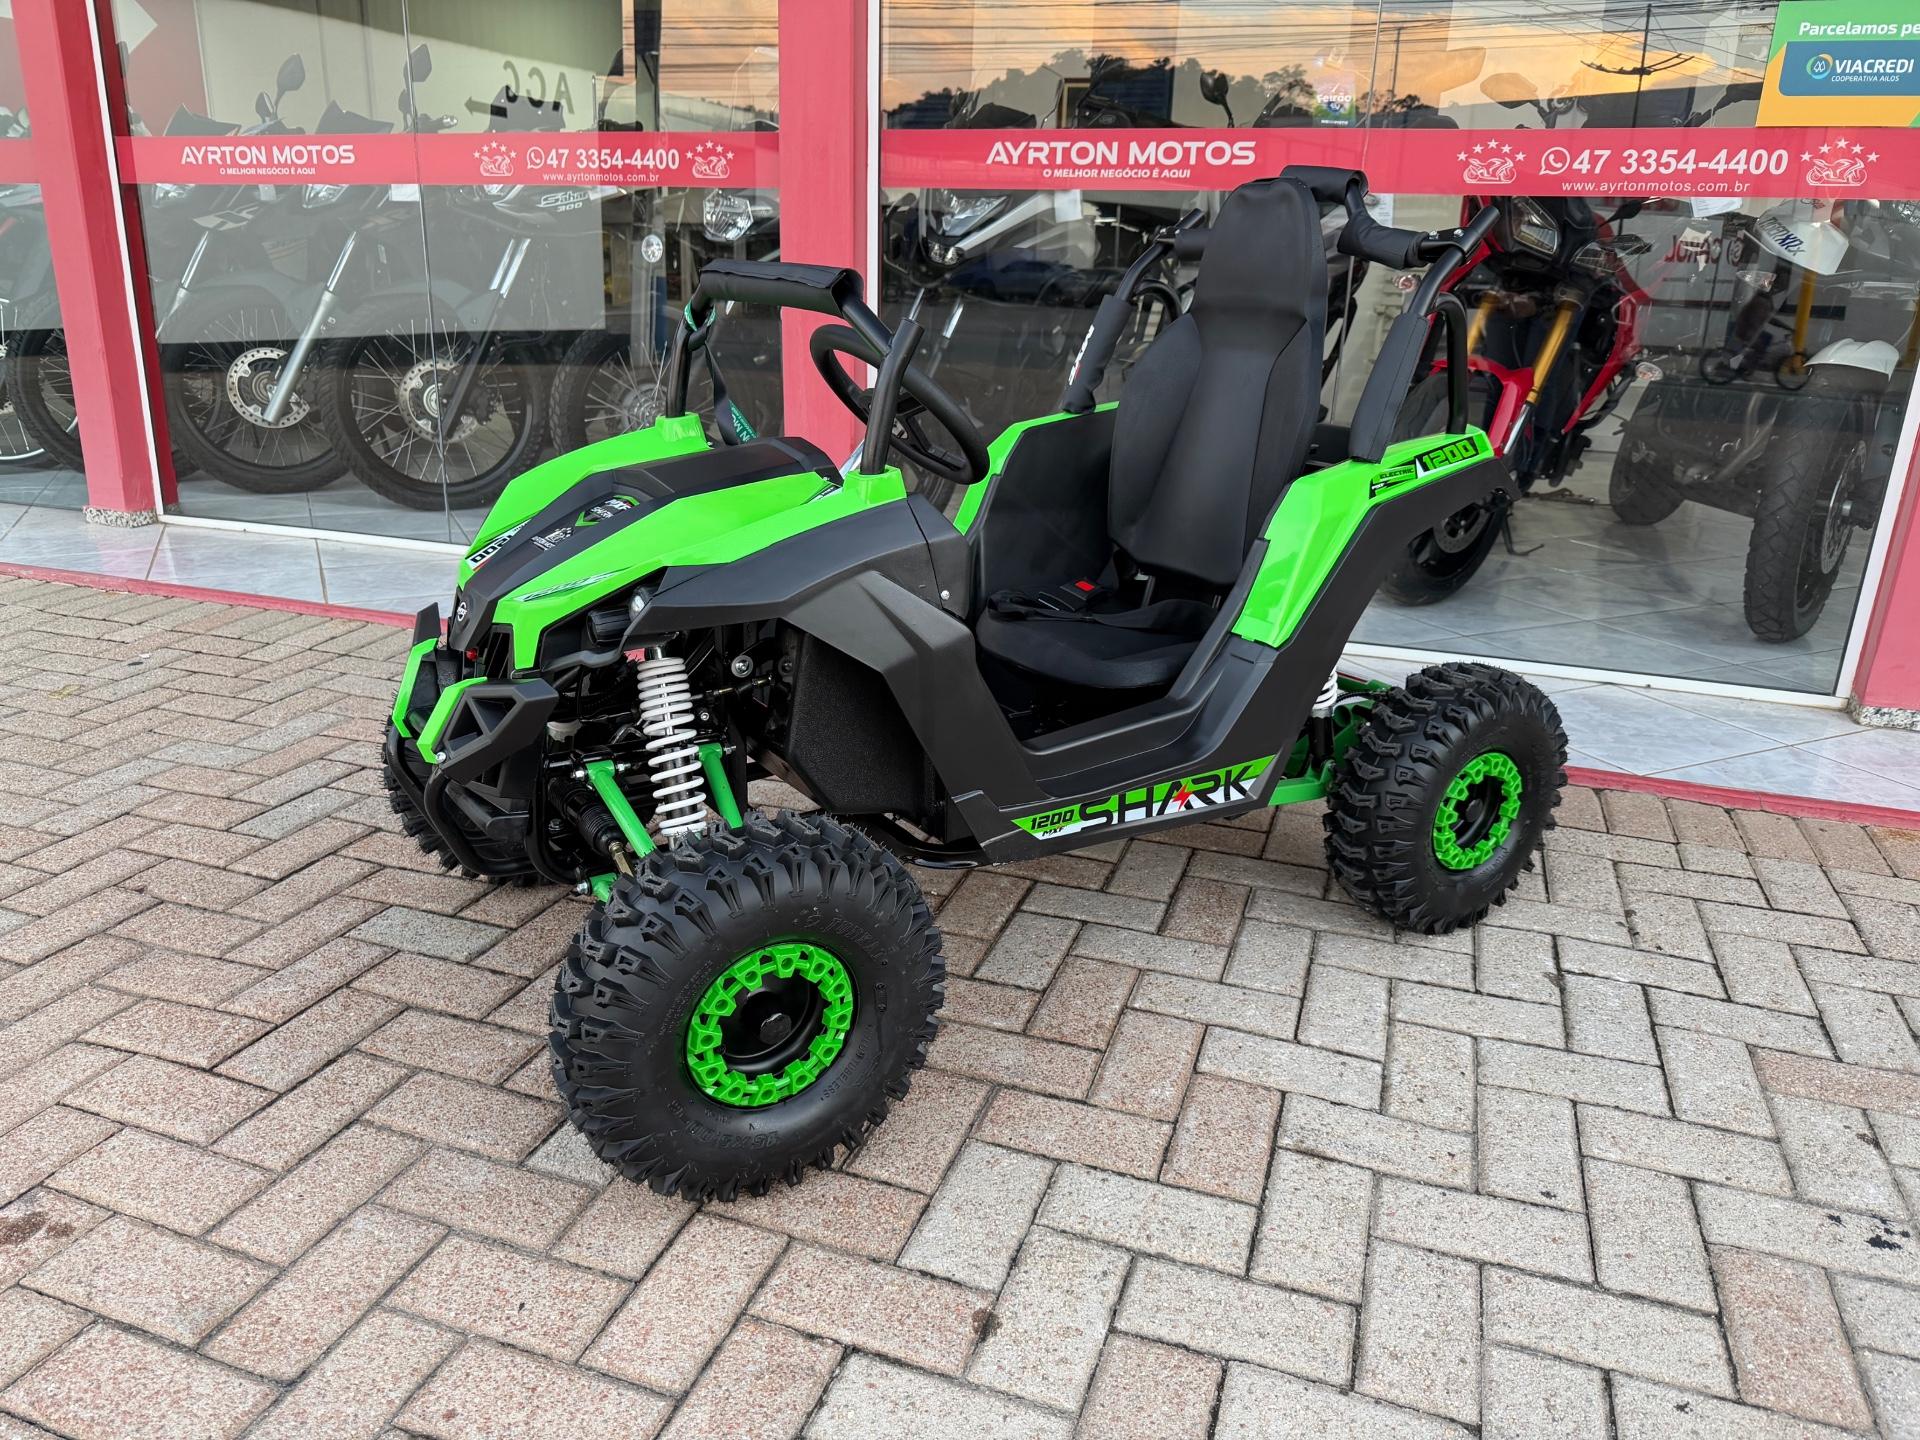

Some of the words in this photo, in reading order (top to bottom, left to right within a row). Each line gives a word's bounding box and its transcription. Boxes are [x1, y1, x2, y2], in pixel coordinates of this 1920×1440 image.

[1799, 21, 1897, 36] Parcelamos
[1835, 58, 1915, 74] VIACREDI
[181, 145, 267, 165] AYRTON
[273, 144, 356, 165] MOTOS
[546, 149, 570, 169] 47
[576, 148, 680, 170] 3354-4400
[985, 141, 1118, 165] AYRTON
[1128, 140, 1257, 166] MOTOS
[1572, 149, 1612, 175] 47
[1619, 148, 1789, 175] 3354-4400
[219, 168, 226, 176] O
[226, 167, 256, 176] MELHOR
[257, 167, 290, 176] NEGÓCIO
[290, 167, 296, 175] É
[296, 167, 316, 175] AQUI
[542, 171, 660, 183] www.ayrtonmotos.com.br
[1043, 168, 1052, 178] O
[1053, 168, 1098, 179] MELHOR
[1100, 167, 1150, 179] NEGÓCIO
[1152, 167, 1160, 179] É
[1161, 168, 1191, 179] AQUI
[1561, 180, 1751, 194] www.ayrtonmotos.com.br
[1422, 440, 1477, 471] 1200
[1380, 468, 1415, 479] ELECTRIC
[1078, 764, 1255, 827] SHARK
[1030, 809, 1075, 831] 1200
